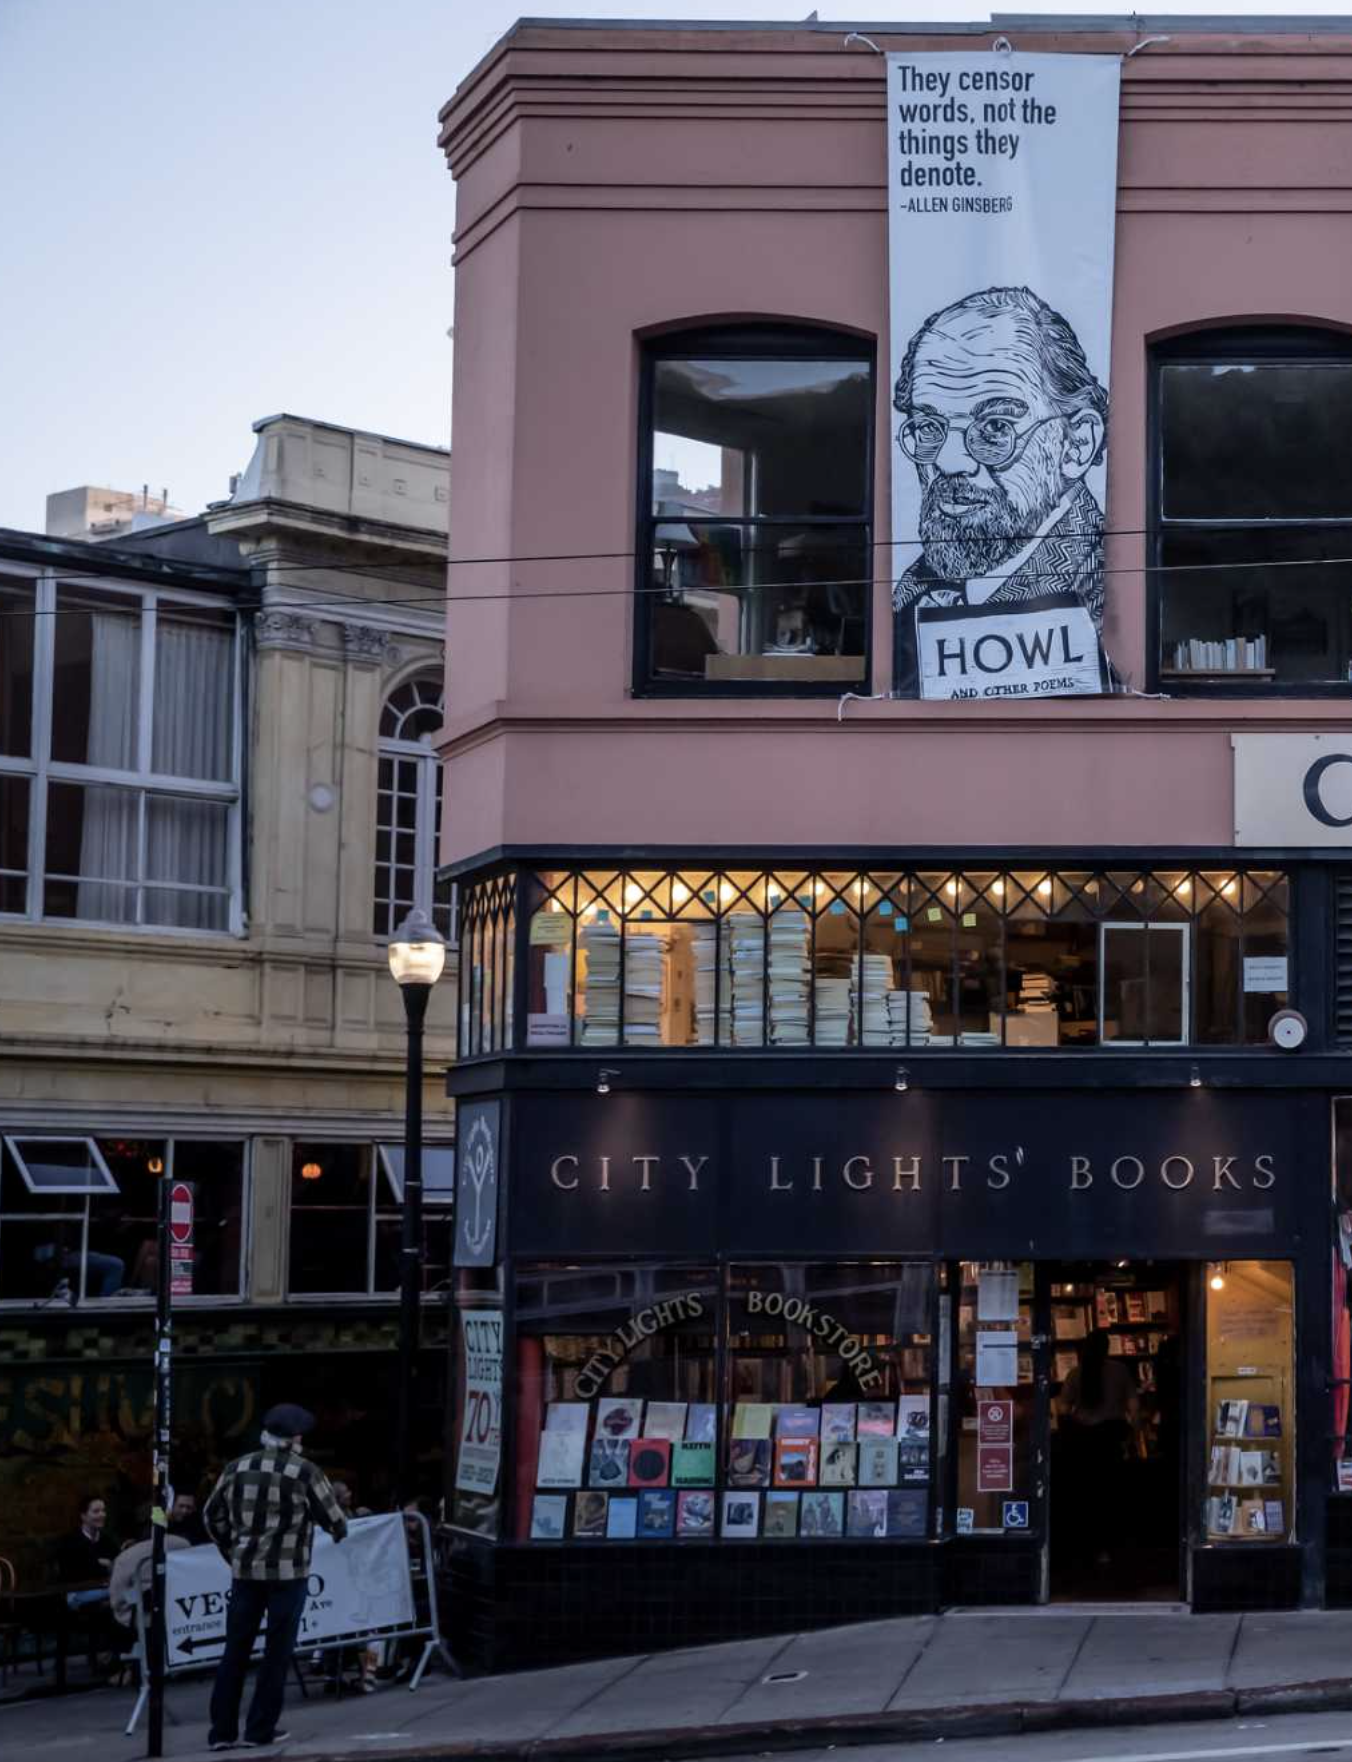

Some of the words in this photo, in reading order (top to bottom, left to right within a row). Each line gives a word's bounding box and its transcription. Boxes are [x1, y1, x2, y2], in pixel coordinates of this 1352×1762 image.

[898, 65, 950, 98] They
[959, 70, 1035, 92] censor
[899, 97, 975, 123] words,
[983, 98, 1015, 123] not
[1022, 97, 1057, 124] the
[898, 128, 968, 161] things
[976, 128, 1020, 160] they
[900, 160, 983, 187] denote.
[952, 196, 1013, 213] GINSBERG
[936, 625, 1084, 676] HOWL
[951, 688, 978, 700] AND
[984, 683, 1029, 696] OTHER
[1033, 677, 1075, 692] POEMS
[550, 1155, 710, 1191] CITY
[1069, 1155, 1277, 1190] BOOKS
[466, 1321, 502, 1353] CITY
[574, 1337, 621, 1399] CITY
[614, 1292, 704, 1349] LIGHTS
[747, 1290, 883, 1392] BOOKSTORE
